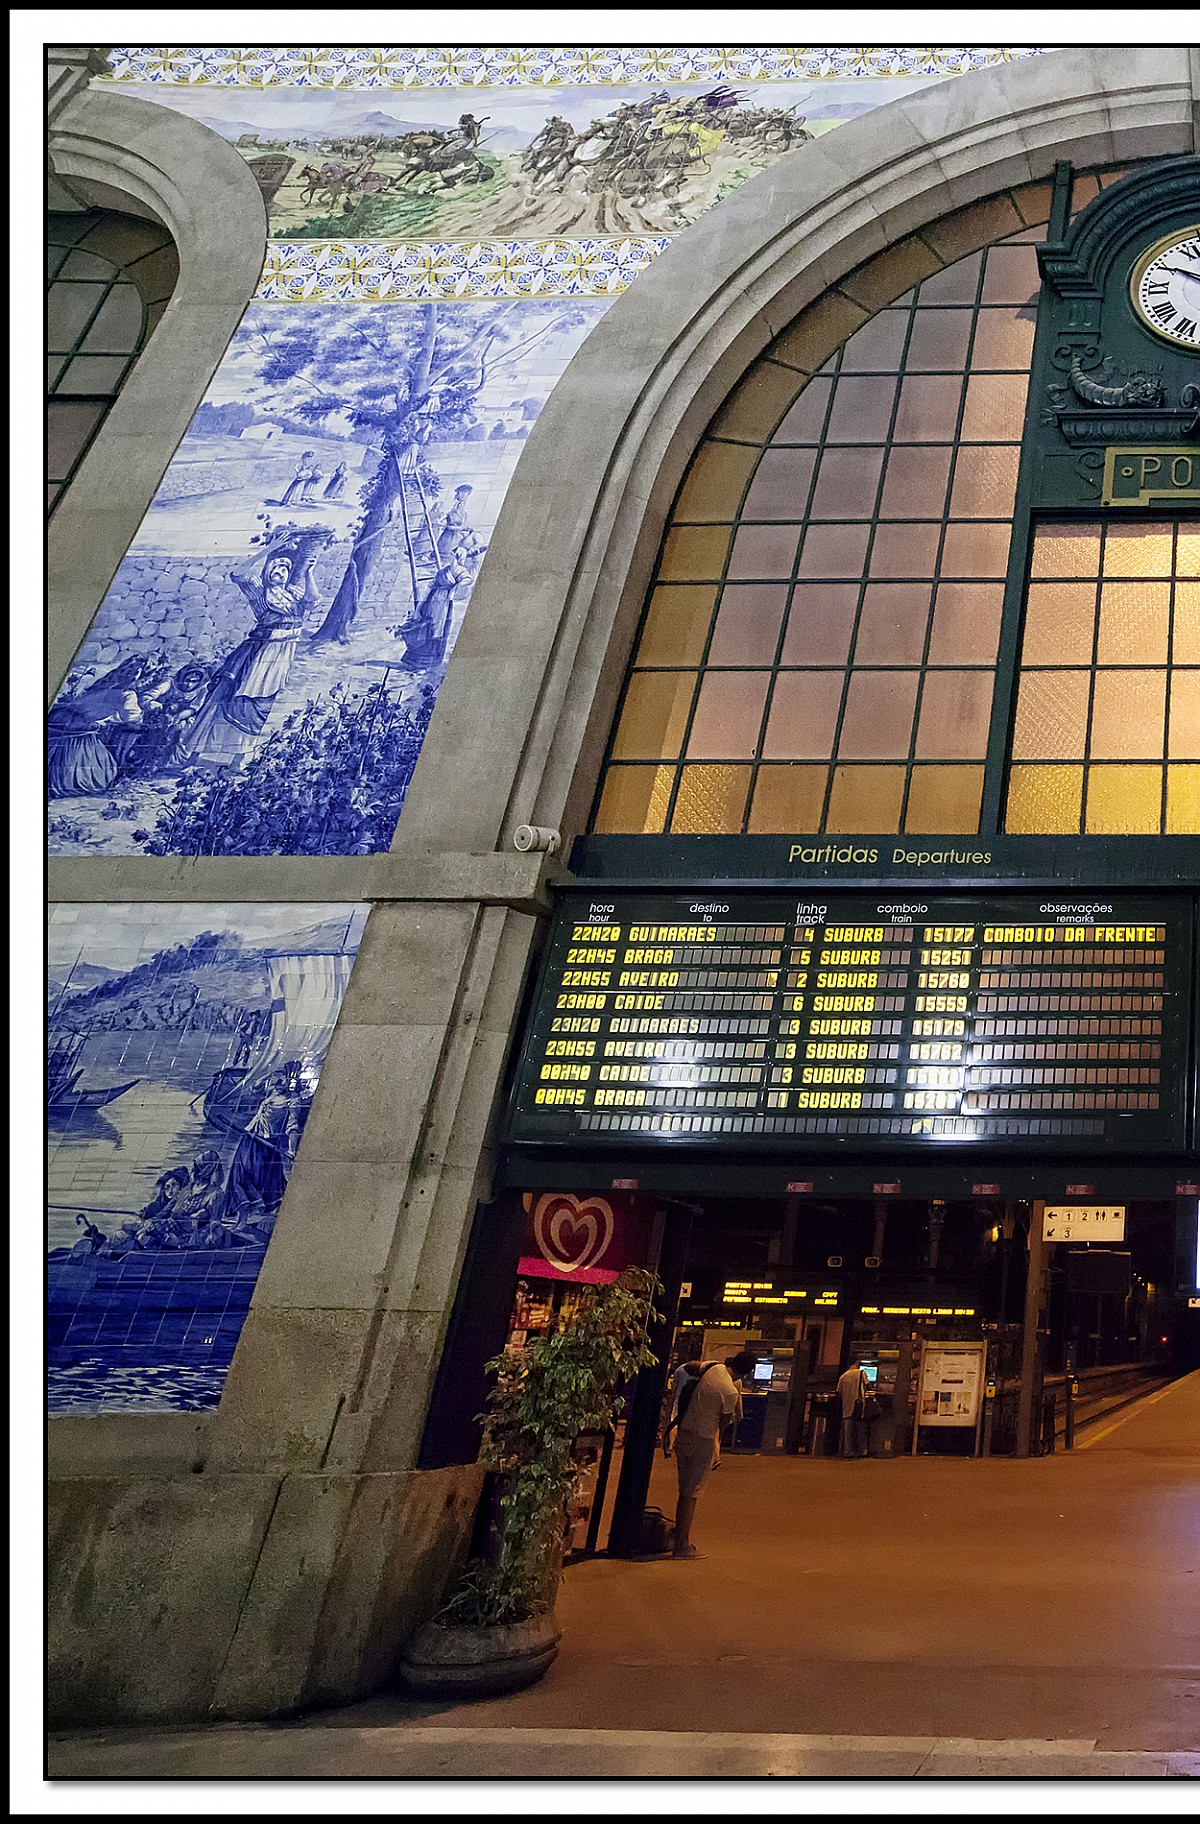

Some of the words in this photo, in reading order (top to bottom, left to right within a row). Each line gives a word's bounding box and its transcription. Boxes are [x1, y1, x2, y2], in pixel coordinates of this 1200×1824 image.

[788, 844, 878, 864] Partidas
[892, 848, 992, 866] Departures
[589, 903, 614, 913] hora
[689, 903, 730, 913] destino
[796, 902, 827, 915] linha
[877, 903, 928, 914] comboio
[1039, 903, 1113, 917] observações
[588, 914, 610, 922] hour
[703, 914, 713, 922] to
[796, 914, 825, 924] track
[890, 914, 912, 923] train
[1056, 914, 1095, 923] remarks
[572, 927, 621, 942] 22H20
[628, 927, 717, 942] GUIMARAES
[804, 928, 815, 942] 4
[823, 928, 884, 942] SUBURB
[923, 928, 975, 942] 15177
[983, 928, 1055, 942] COMBOIO
[1064, 928, 1085, 942] DA
[1094, 928, 1156, 942] FRENTE
[566, 949, 617, 964] 22H45
[624, 950, 674, 964] BRAGA
[799, 950, 811, 965] 5
[820, 950, 881, 965] SUBURB
[920, 950, 972, 965] 15251
[561, 972, 611, 987] 22H55
[618, 972, 679, 987] AVEIRO
[796, 973, 808, 988] 2
[816, 973, 878, 988] SUBURB
[556, 994, 607, 1009] 23H00
[614, 995, 665, 1010] CAIDE
[792, 996, 804, 1011] 6
[813, 996, 875, 1011] SUBURB
[915, 996, 968, 1012] 15559
[551, 1017, 601, 1032] 23H20
[609, 1018, 700, 1034] GUIMARAES
[788, 1019, 801, 1034] 3
[809, 1019, 872, 1035] SUBURB
[545, 1040, 597, 1056] 23H55
[603, 1041, 666, 1058] AVEIRO
[784, 1043, 797, 1059] 3
[805, 1043, 869, 1059] SUBURB
[540, 1064, 591, 1080] 00H40
[599, 1065, 650, 1081] CAIDE
[781, 1067, 794, 1083] 3
[801, 1067, 866, 1083] SUBURB
[534, 1088, 587, 1105] 00H45
[593, 1090, 646, 1106] BRAGA
[777, 1092, 787, 1108] 1
[798, 1092, 862, 1108] SUBURB
[1081, 1212, 1088, 1221] 2
[1063, 1229, 1071, 1238] 3
